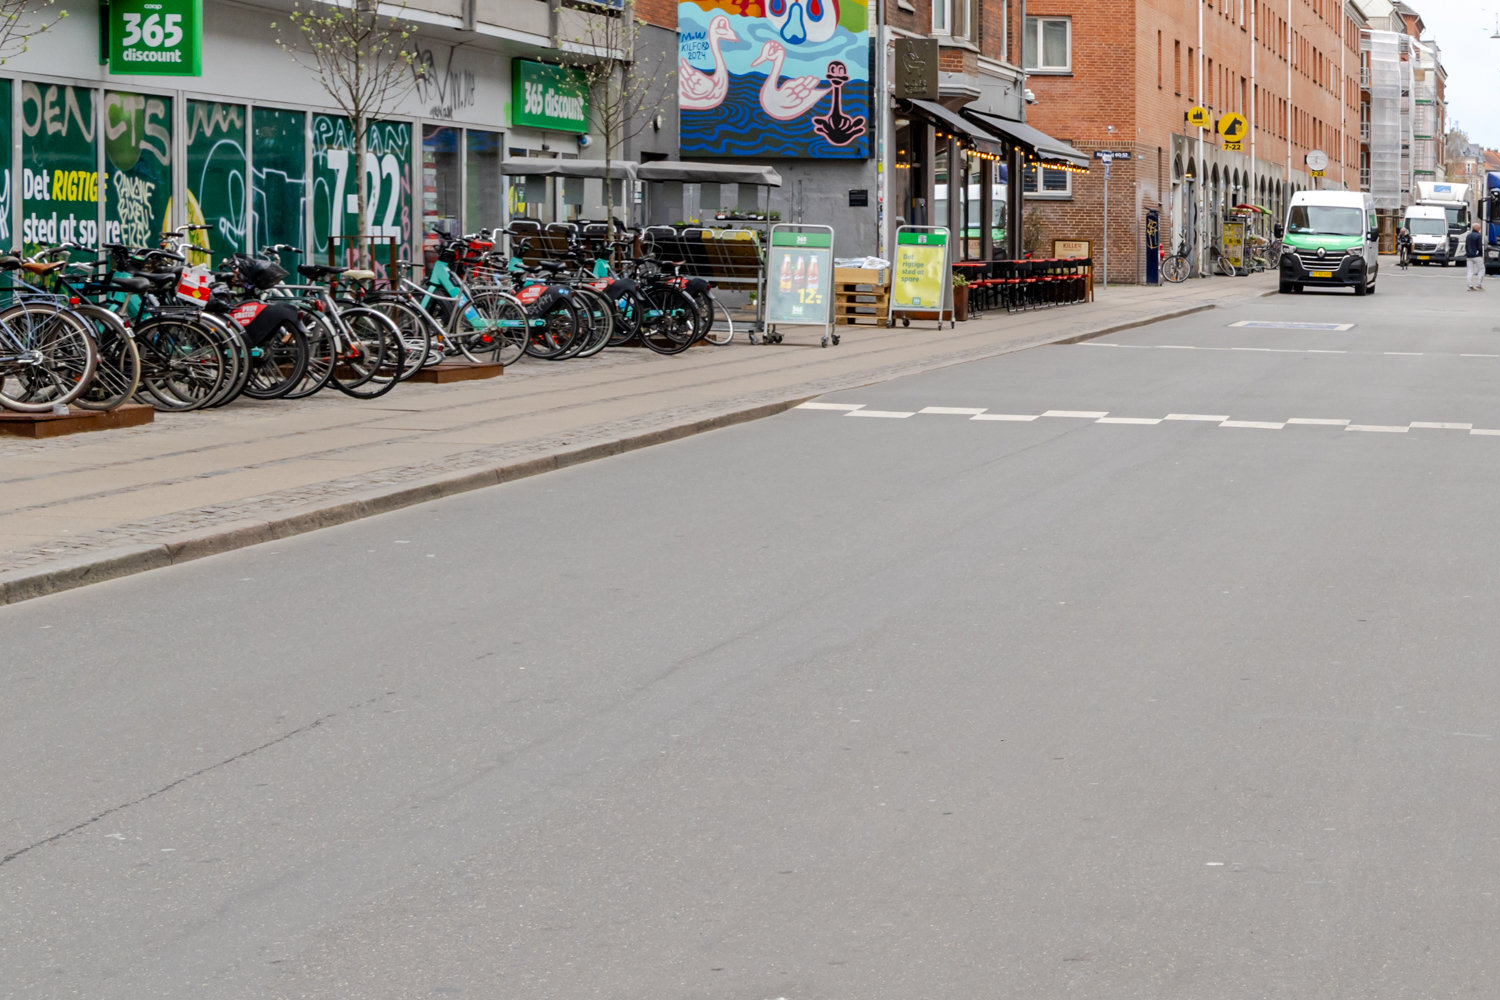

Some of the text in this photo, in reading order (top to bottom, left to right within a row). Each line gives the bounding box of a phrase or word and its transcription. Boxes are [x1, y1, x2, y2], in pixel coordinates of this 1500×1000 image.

[122, 13, 183, 48] 365
[122, 48, 182, 63] discount
[524, 82, 585, 121] 365 discount
[23, 168, 50, 200] Det
[327, 149, 401, 246] 7-22
[23, 212, 121, 250] sted at spre
